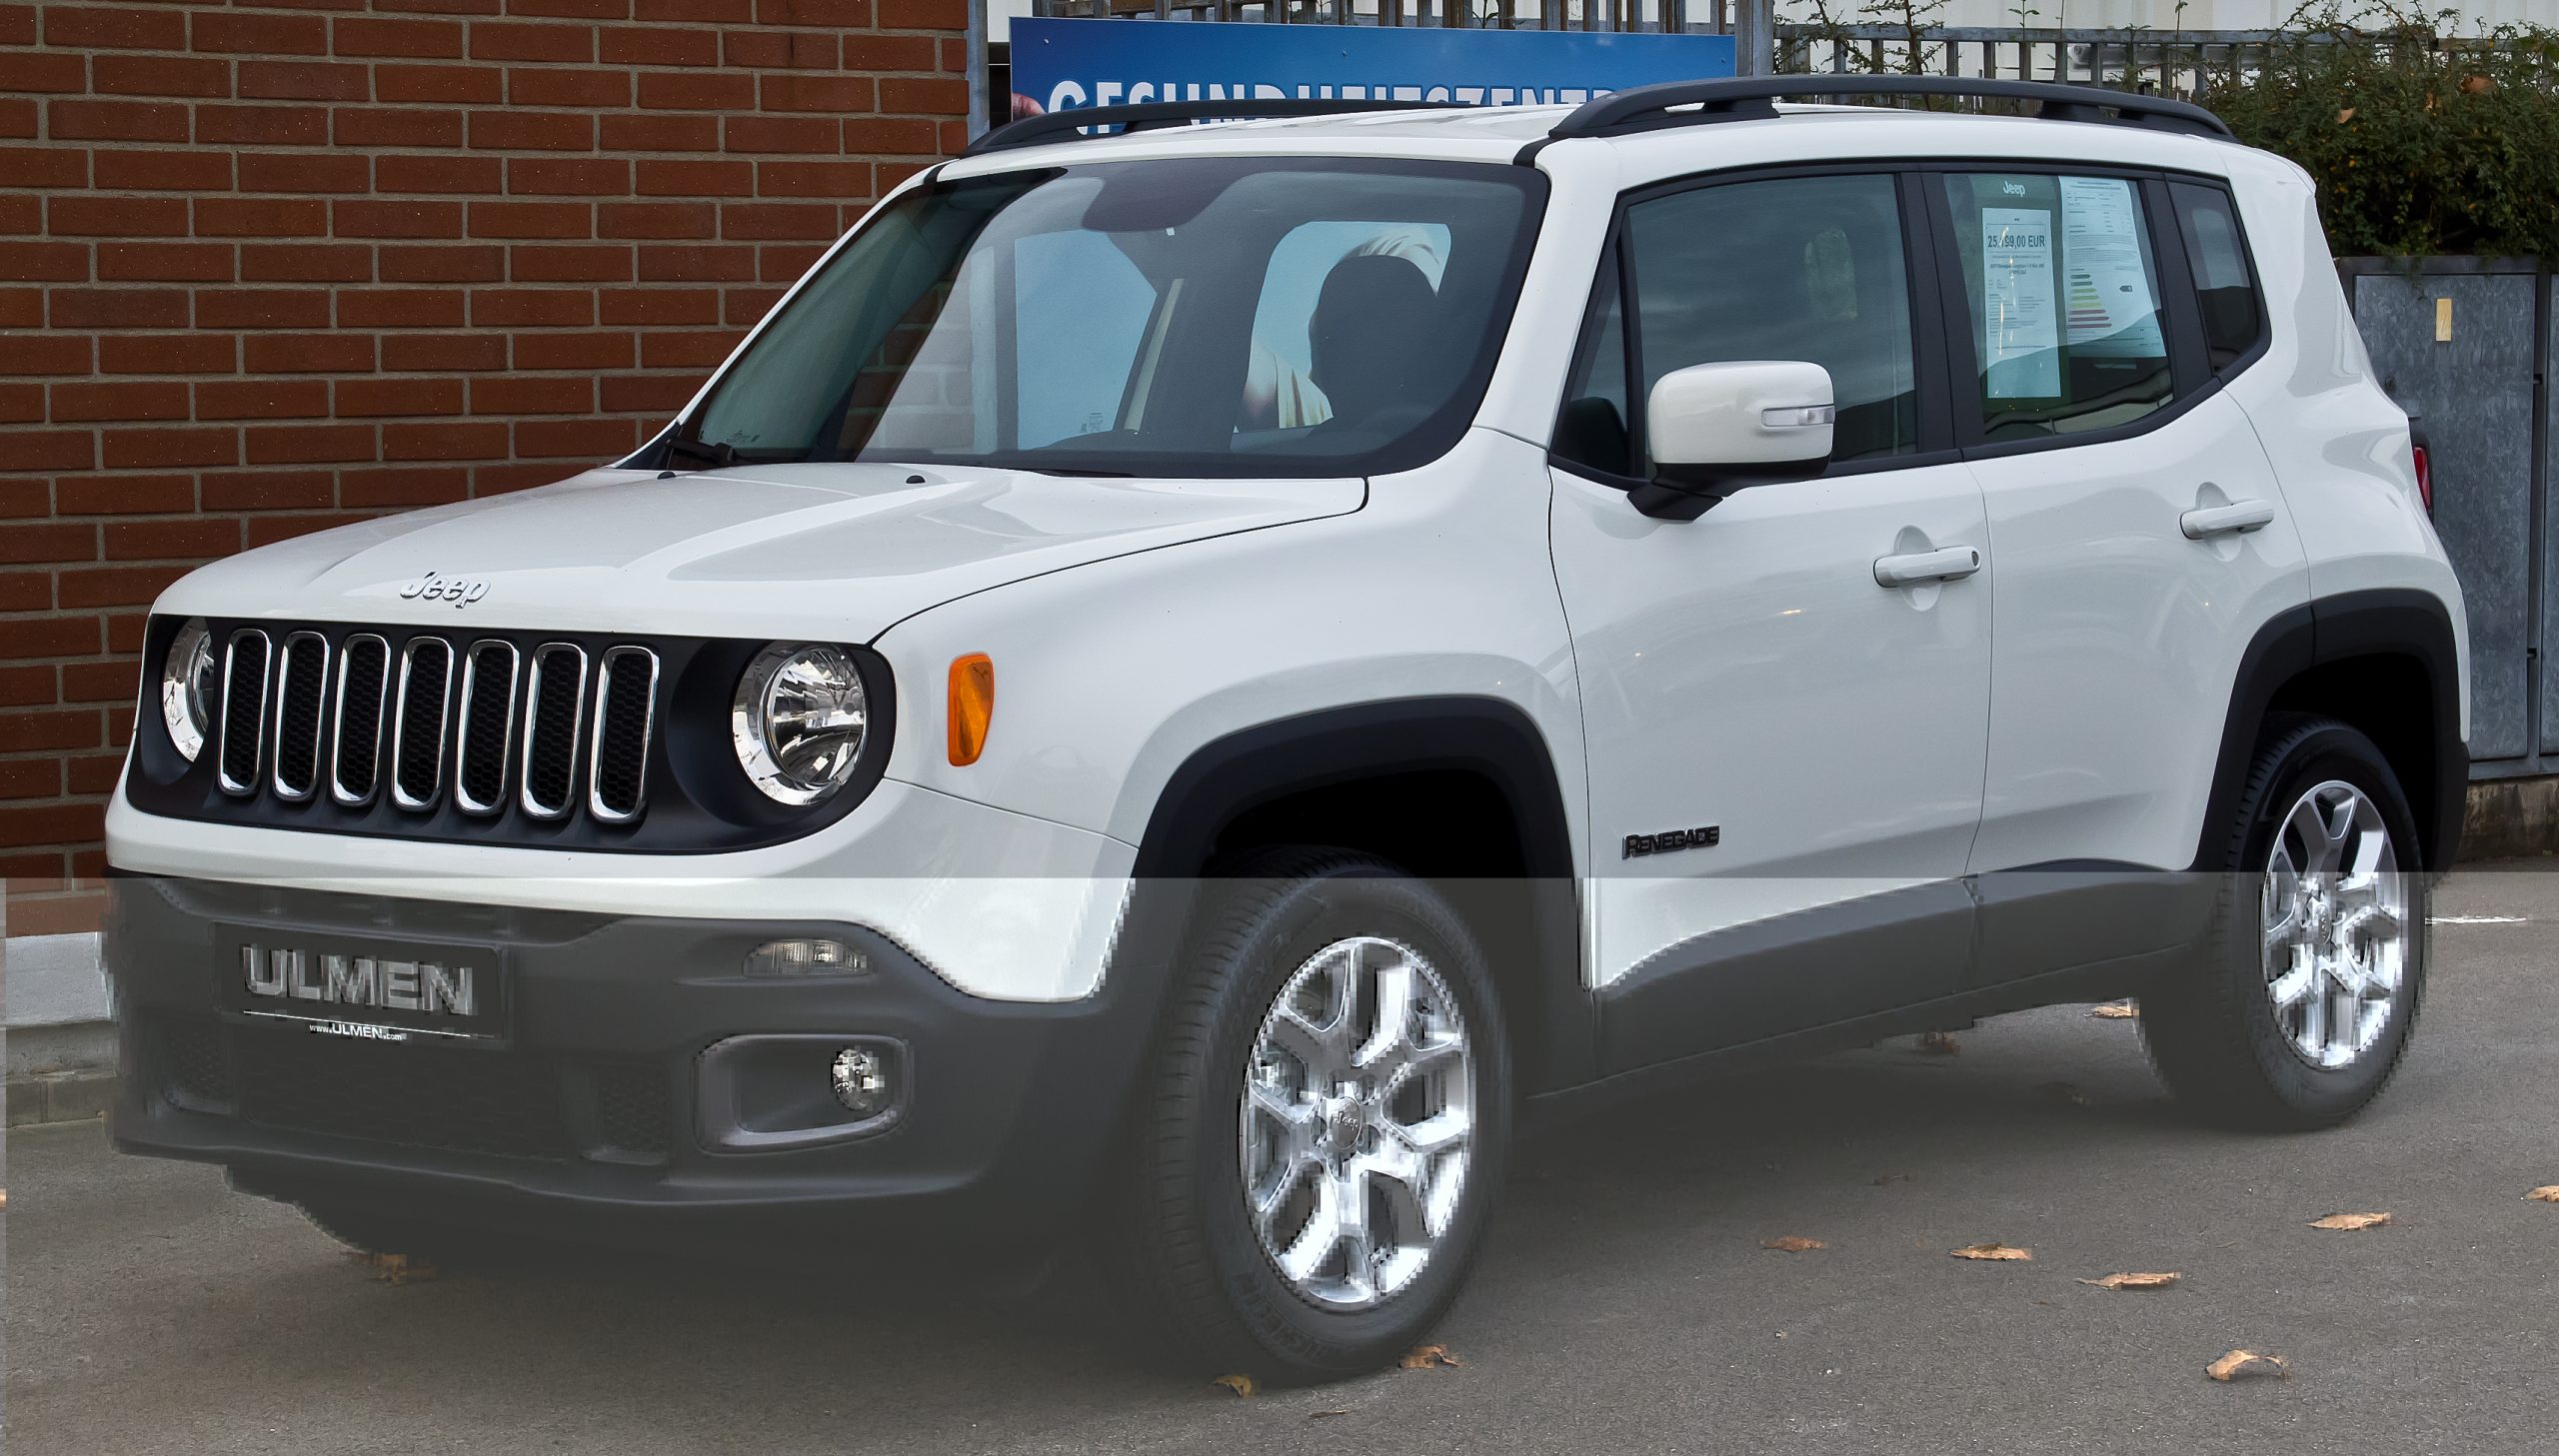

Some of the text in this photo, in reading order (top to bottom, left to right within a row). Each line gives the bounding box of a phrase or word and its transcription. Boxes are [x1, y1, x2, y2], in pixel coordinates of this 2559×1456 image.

[2002, 180, 2025, 198] Jeep
[2028, 235, 2045, 248] EUR
[400, 571, 491, 609] Jeep
[1622, 824, 1720, 859] RENEGADE
[242, 945, 474, 1015] ULMEN
[309, 1023, 403, 1041] www.ULMEN.com
